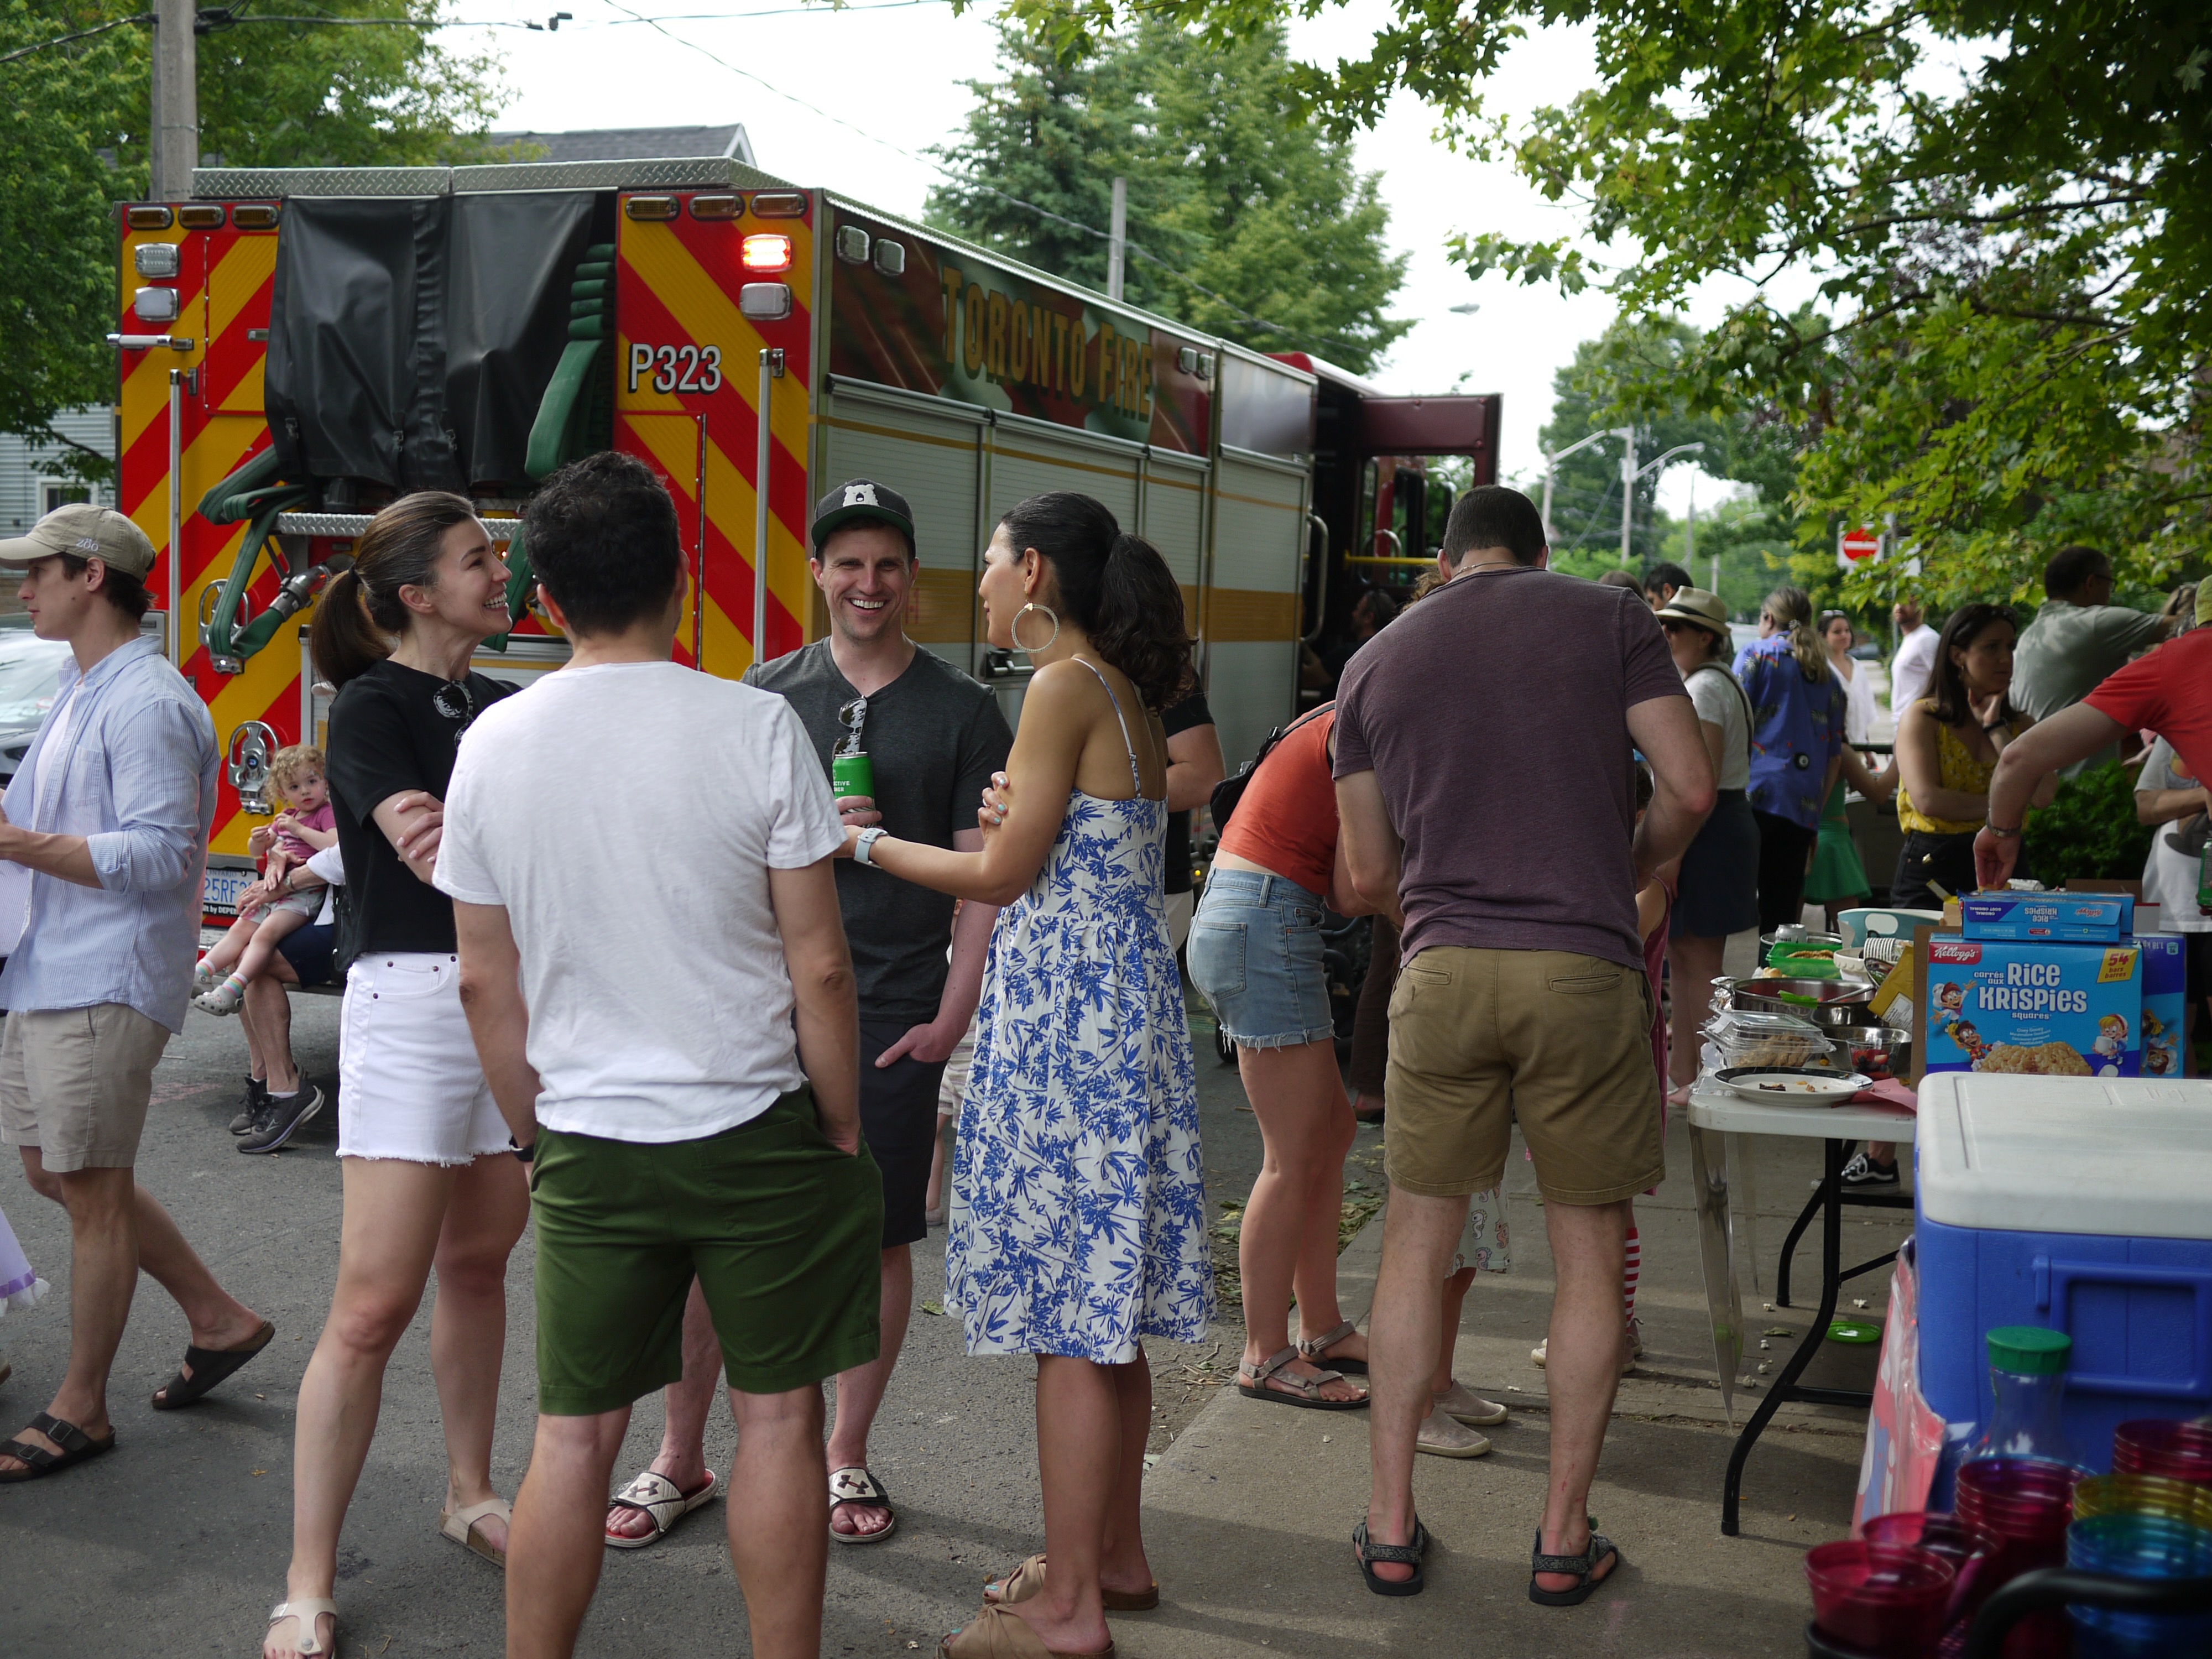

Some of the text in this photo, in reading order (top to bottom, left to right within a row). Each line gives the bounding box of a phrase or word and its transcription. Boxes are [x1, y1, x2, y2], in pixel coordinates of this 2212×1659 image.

[943, 267, 1152, 418] TORONTO FIRE
[628, 343, 722, 394] P323
[204, 878, 252, 902] 25RF
[210, 905, 217, 914] by
[1934, 946, 1976, 961] Kellogg's
[2108, 952, 2129, 967] 54
[2007, 963, 2060, 987] Rice
